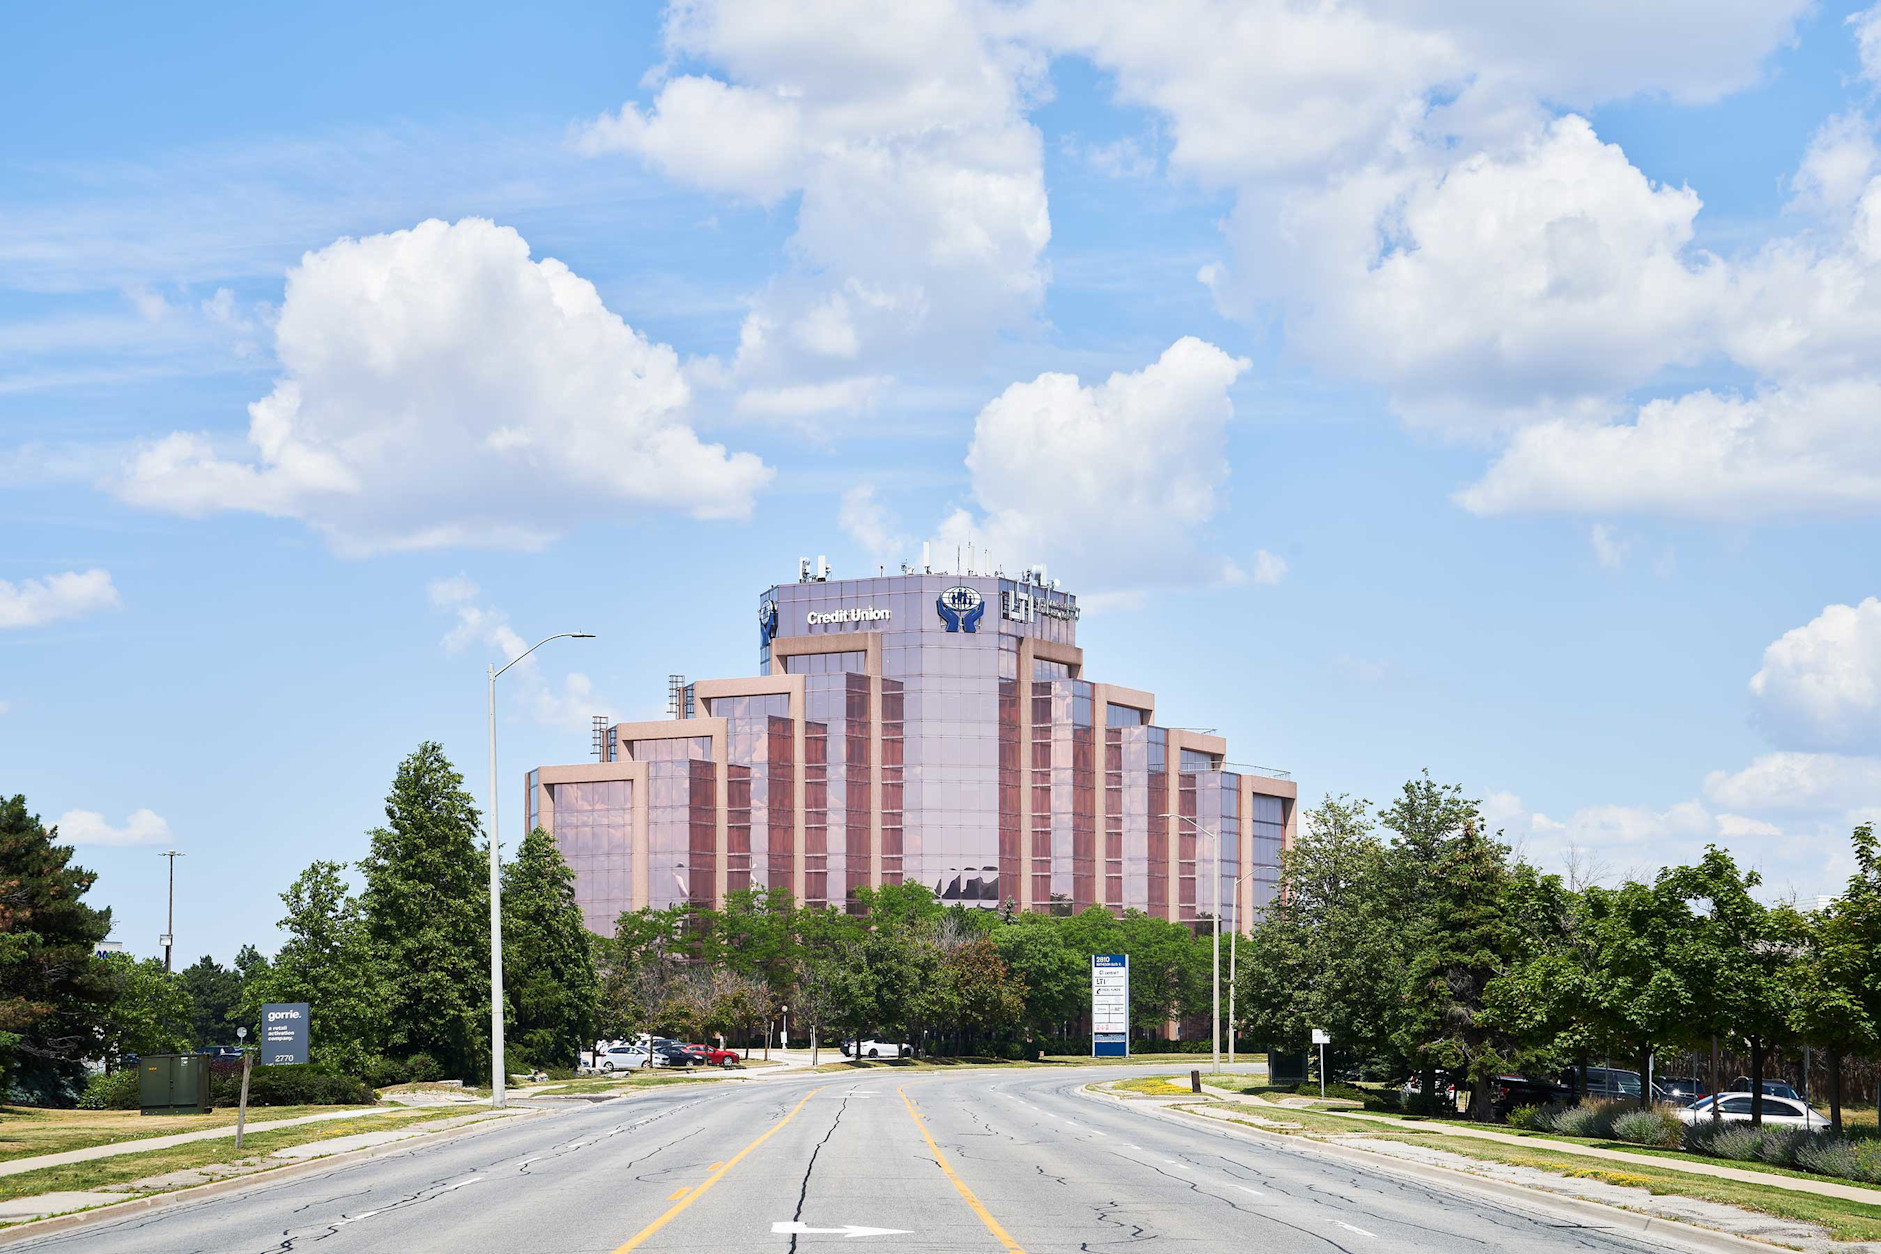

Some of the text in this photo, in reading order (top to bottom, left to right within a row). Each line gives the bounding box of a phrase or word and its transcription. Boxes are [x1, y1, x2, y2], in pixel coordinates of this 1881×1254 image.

[807, 606, 891, 625] Credit Union
[268, 1010, 302, 1022] gorrie.
